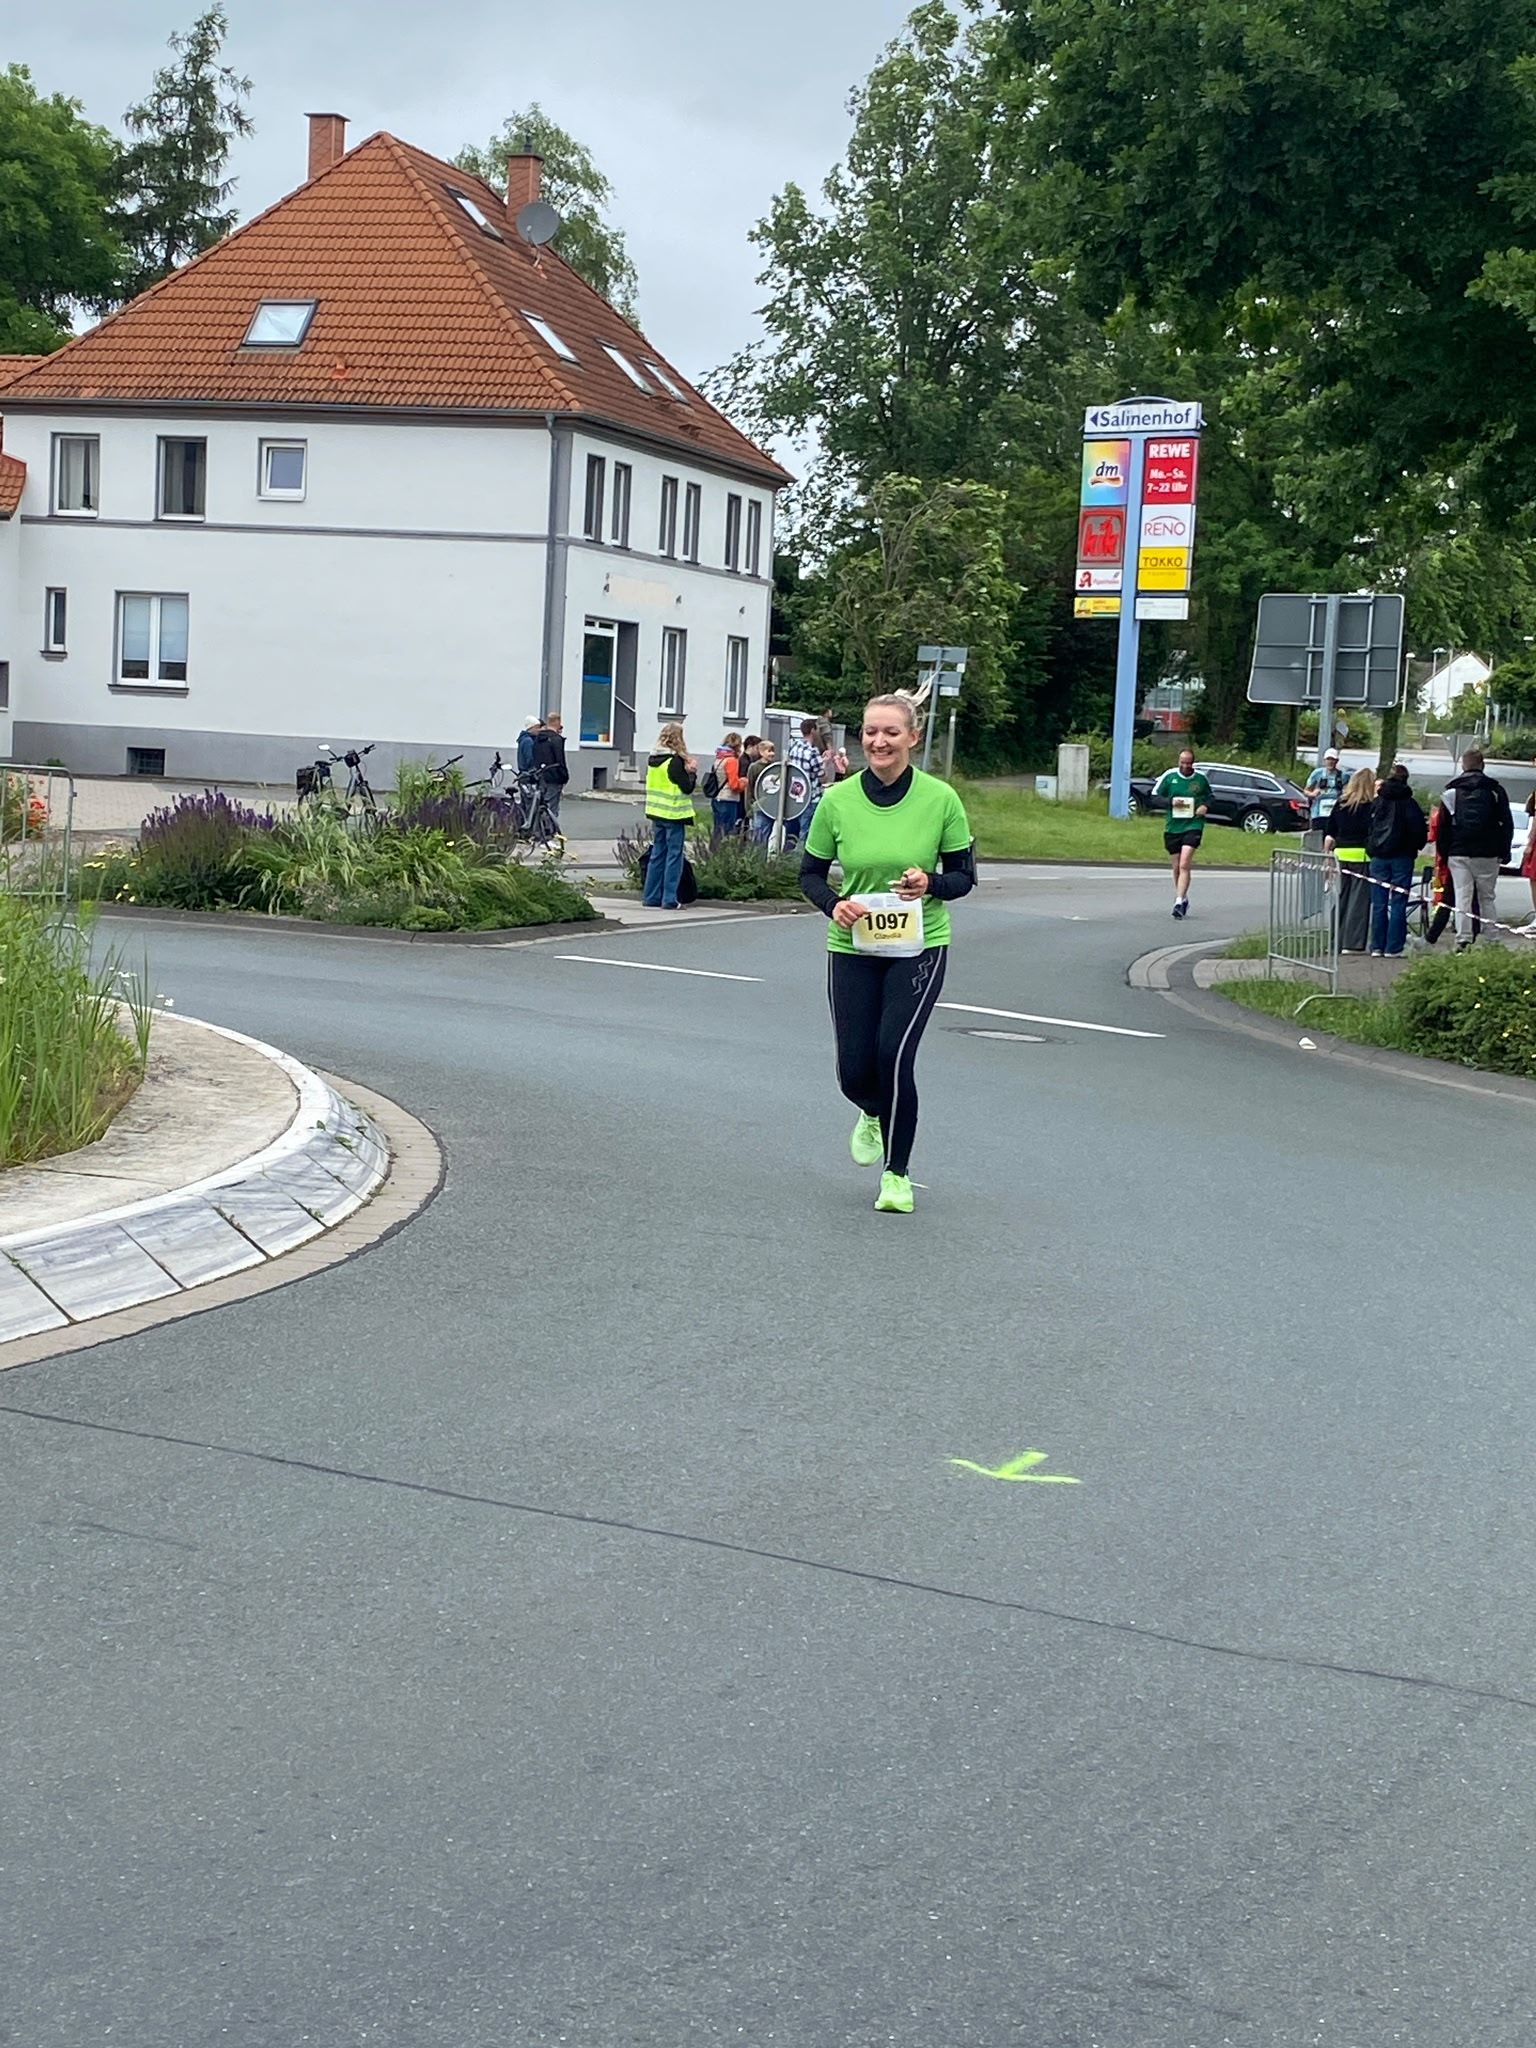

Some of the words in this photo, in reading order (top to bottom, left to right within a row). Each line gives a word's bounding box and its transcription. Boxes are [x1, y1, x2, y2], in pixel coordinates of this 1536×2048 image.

[1100, 407, 1192, 427] Salinenhof
[1149, 443, 1190, 458] REWE
[1096, 461, 1118, 476] dm
[1171, 481, 1188, 492] Uhr
[1144, 521, 1185, 536] RENO
[864, 912, 908, 930] 1097
